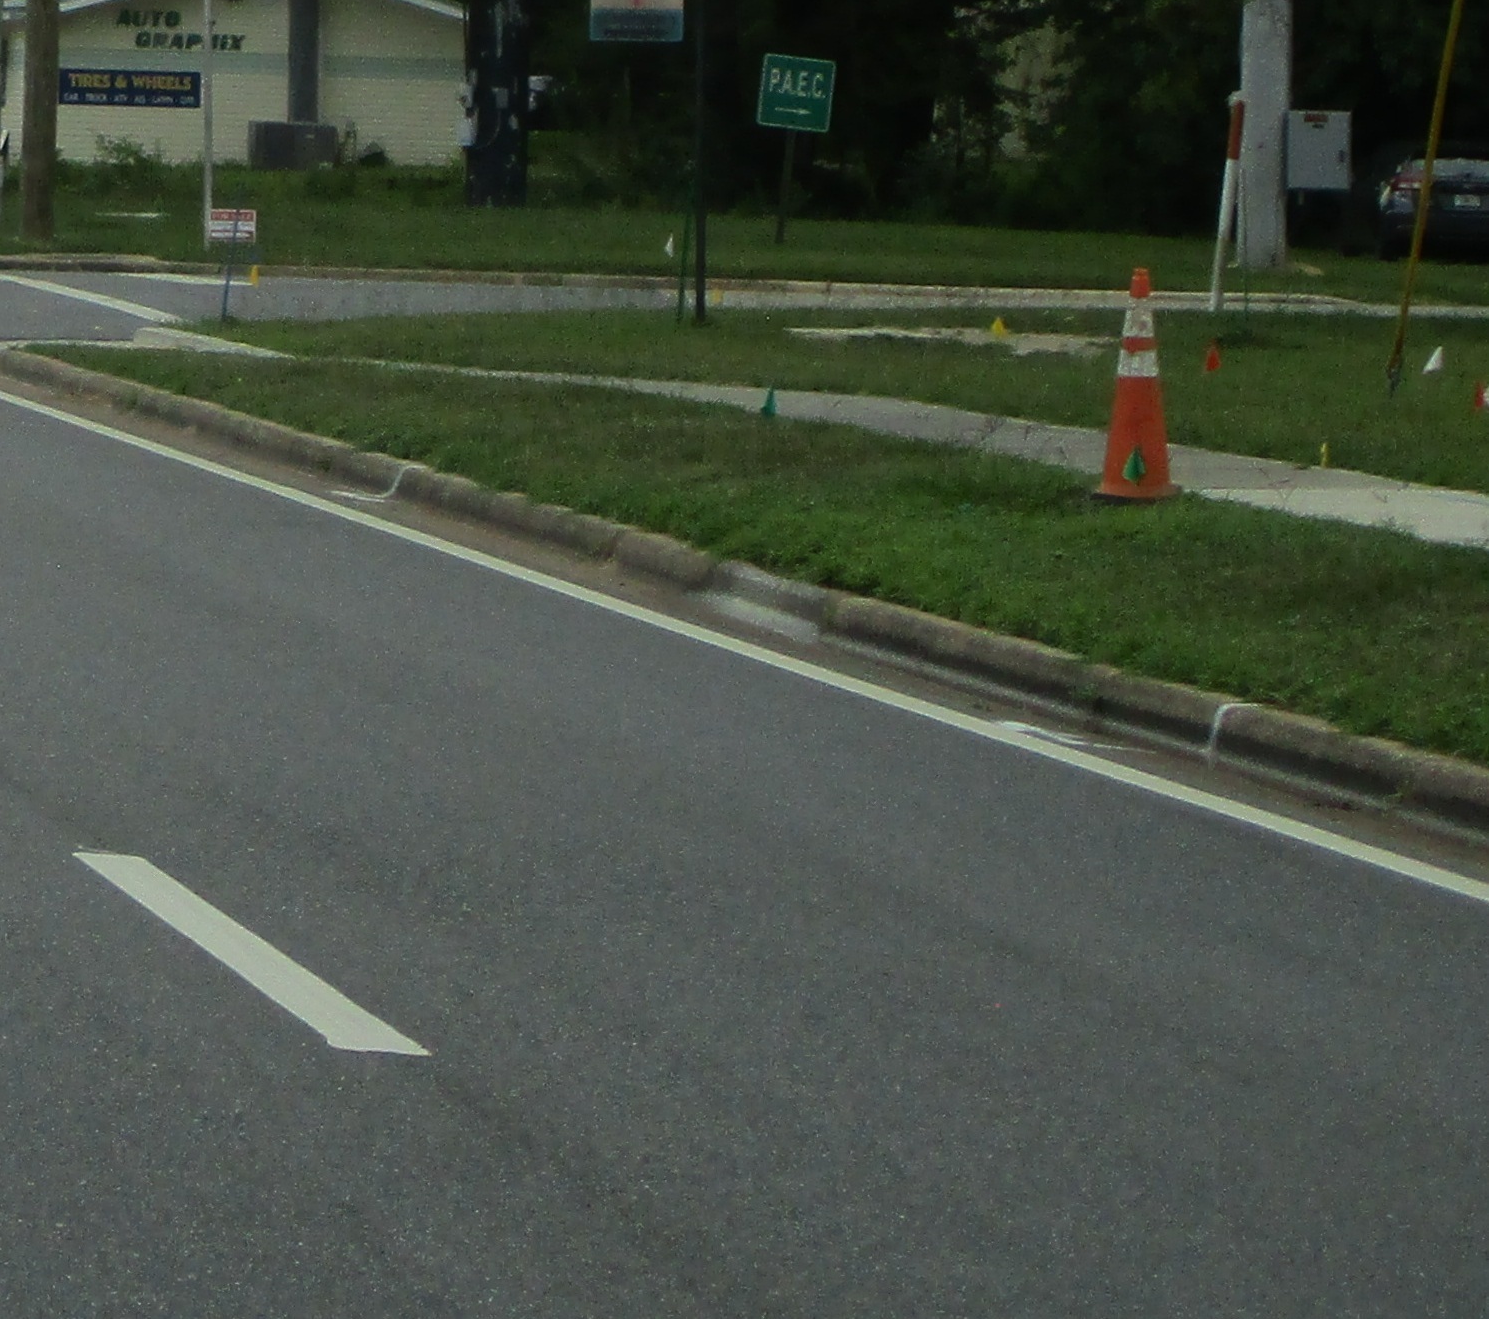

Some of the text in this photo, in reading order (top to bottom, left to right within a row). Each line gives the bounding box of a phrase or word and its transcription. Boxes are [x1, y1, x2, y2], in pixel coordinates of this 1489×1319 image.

[116, 8, 181, 28] AUTO
[68, 73, 112, 89] TIRES
[131, 75, 193, 91] WHEELS
